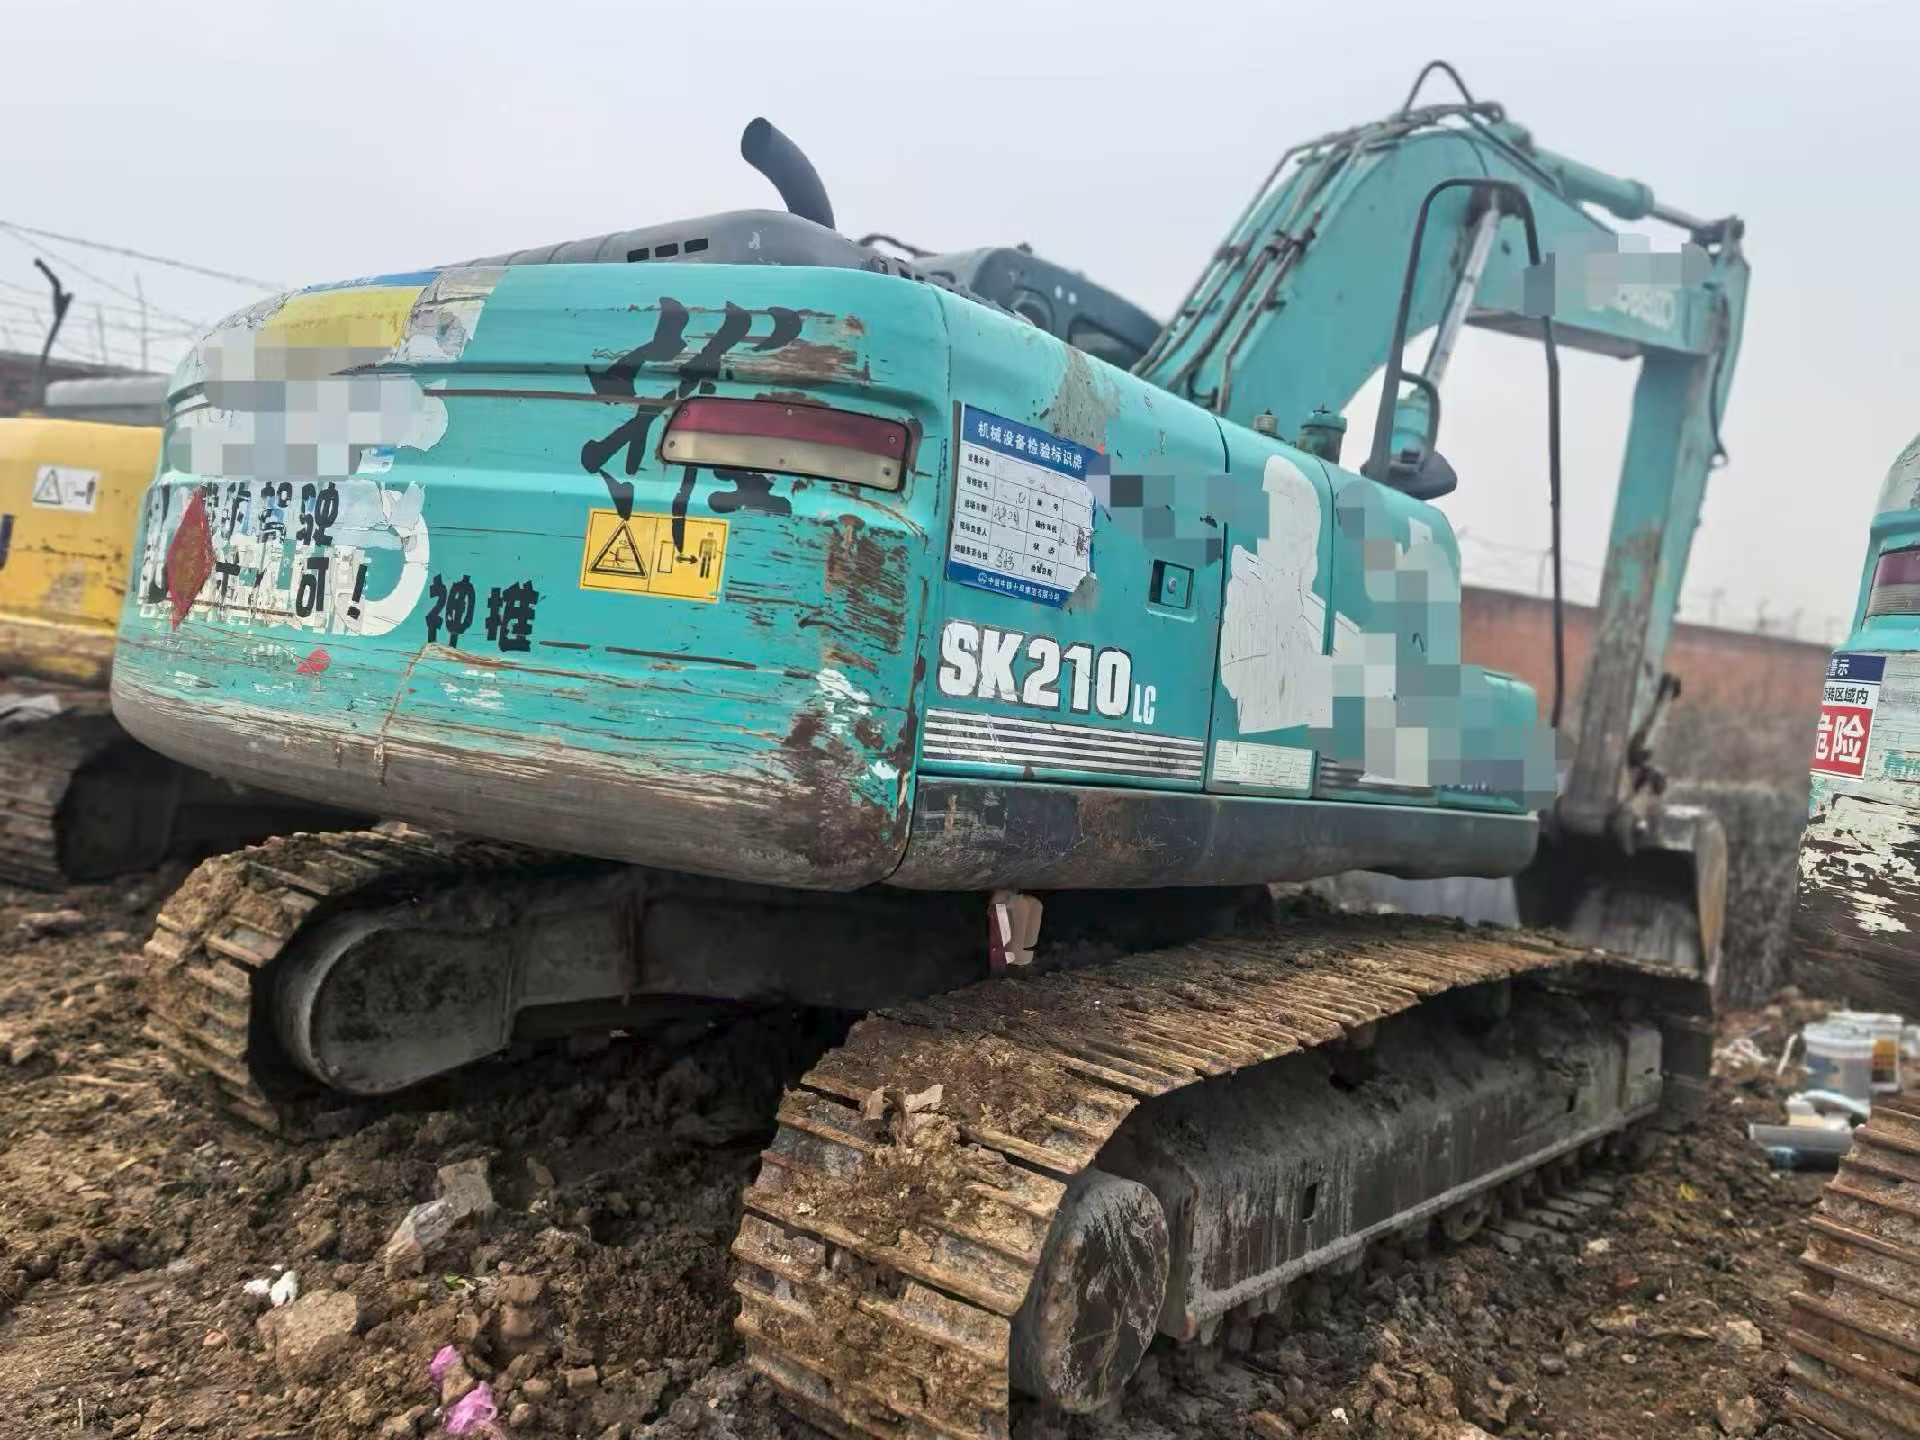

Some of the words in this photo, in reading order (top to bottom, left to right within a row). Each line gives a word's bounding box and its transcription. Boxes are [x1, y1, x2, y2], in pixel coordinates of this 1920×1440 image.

[977, 420, 1083, 470] 机械设备检验标识牌
[425, 573, 540, 652] 神推
[938, 620, 1132, 720] SK210
[1132, 684, 1157, 725] LC
